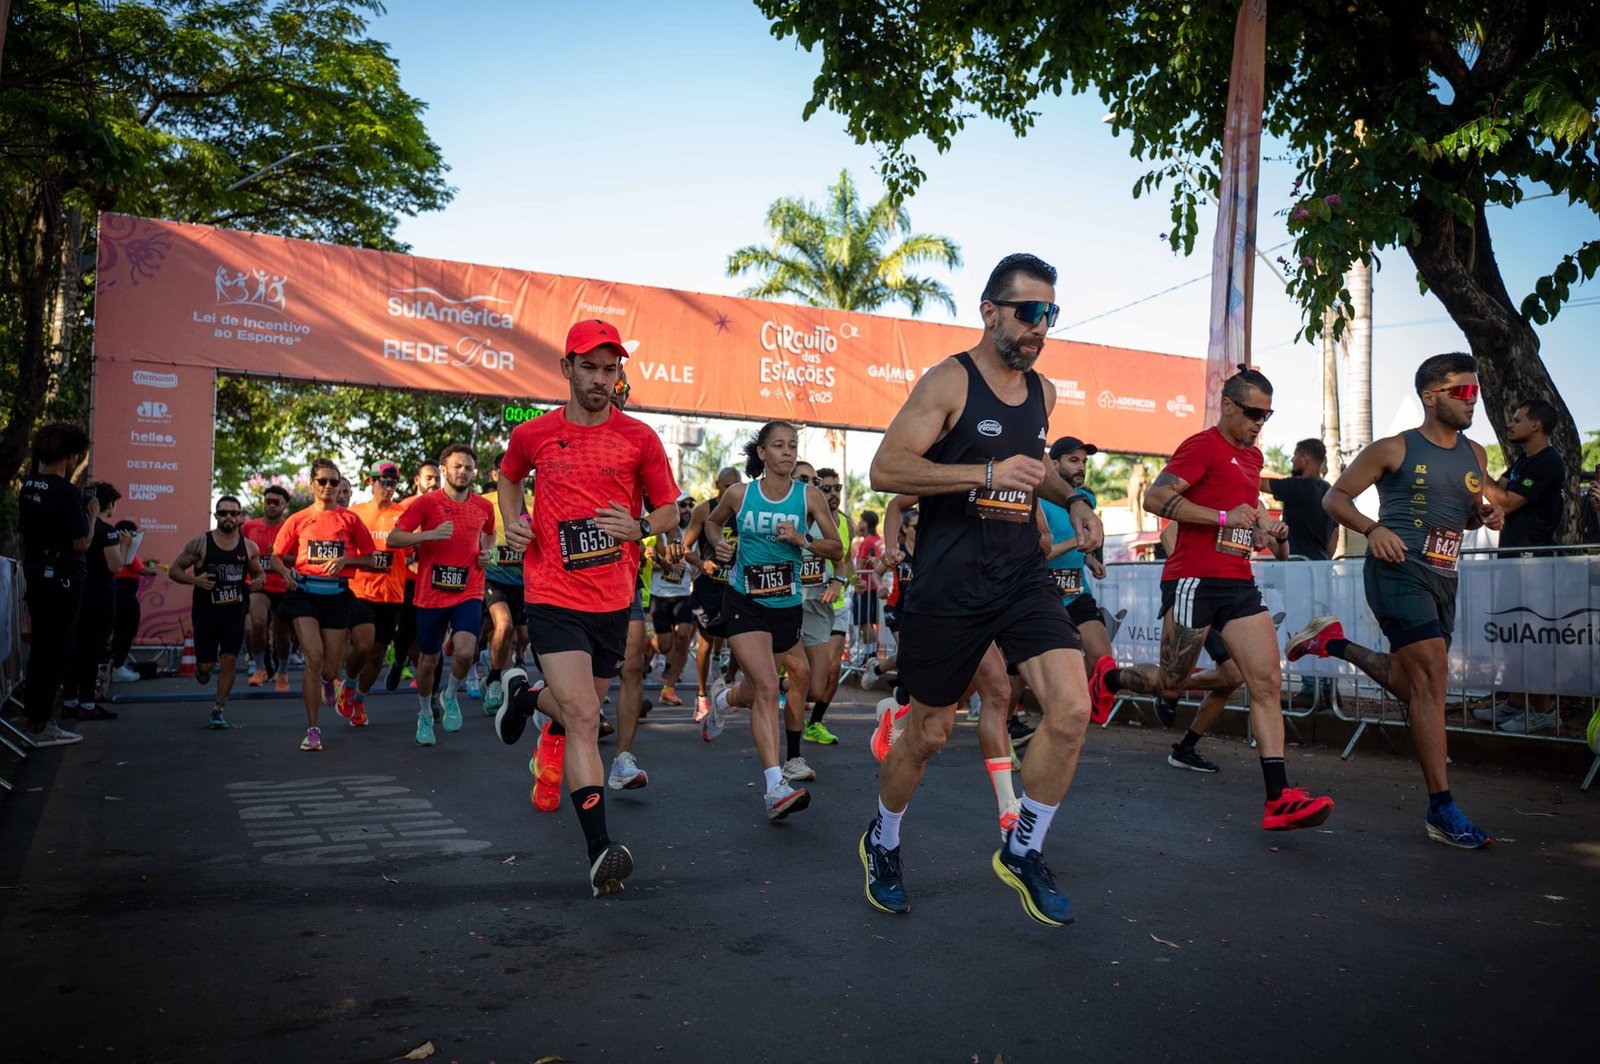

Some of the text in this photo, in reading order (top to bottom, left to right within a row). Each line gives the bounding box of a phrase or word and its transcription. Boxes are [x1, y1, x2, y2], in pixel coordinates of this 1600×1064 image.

[387, 298, 513, 329] SulAmérica
[193, 311, 310, 334] Lei de Incentivo
[214, 327, 294, 346] ao Esporte
[382, 339, 449, 364] REDE
[801, 352, 821, 363] das
[134, 370, 175, 384] Ehrmann
[639, 360, 695, 384] VALE
[808, 390, 833, 404] 2025
[129, 484, 174, 493] RUNNING
[129, 491, 157, 500] LAND
[317, 546, 339, 559] 6250
[441, 571, 463, 584] 5586
[758, 571, 784, 589] 7153
[1055, 575, 1076, 589] 7646
[1127, 626, 1160, 641] VALE
[1014, 802, 1039, 848] RUN
[867, 853, 877, 885] FILA
